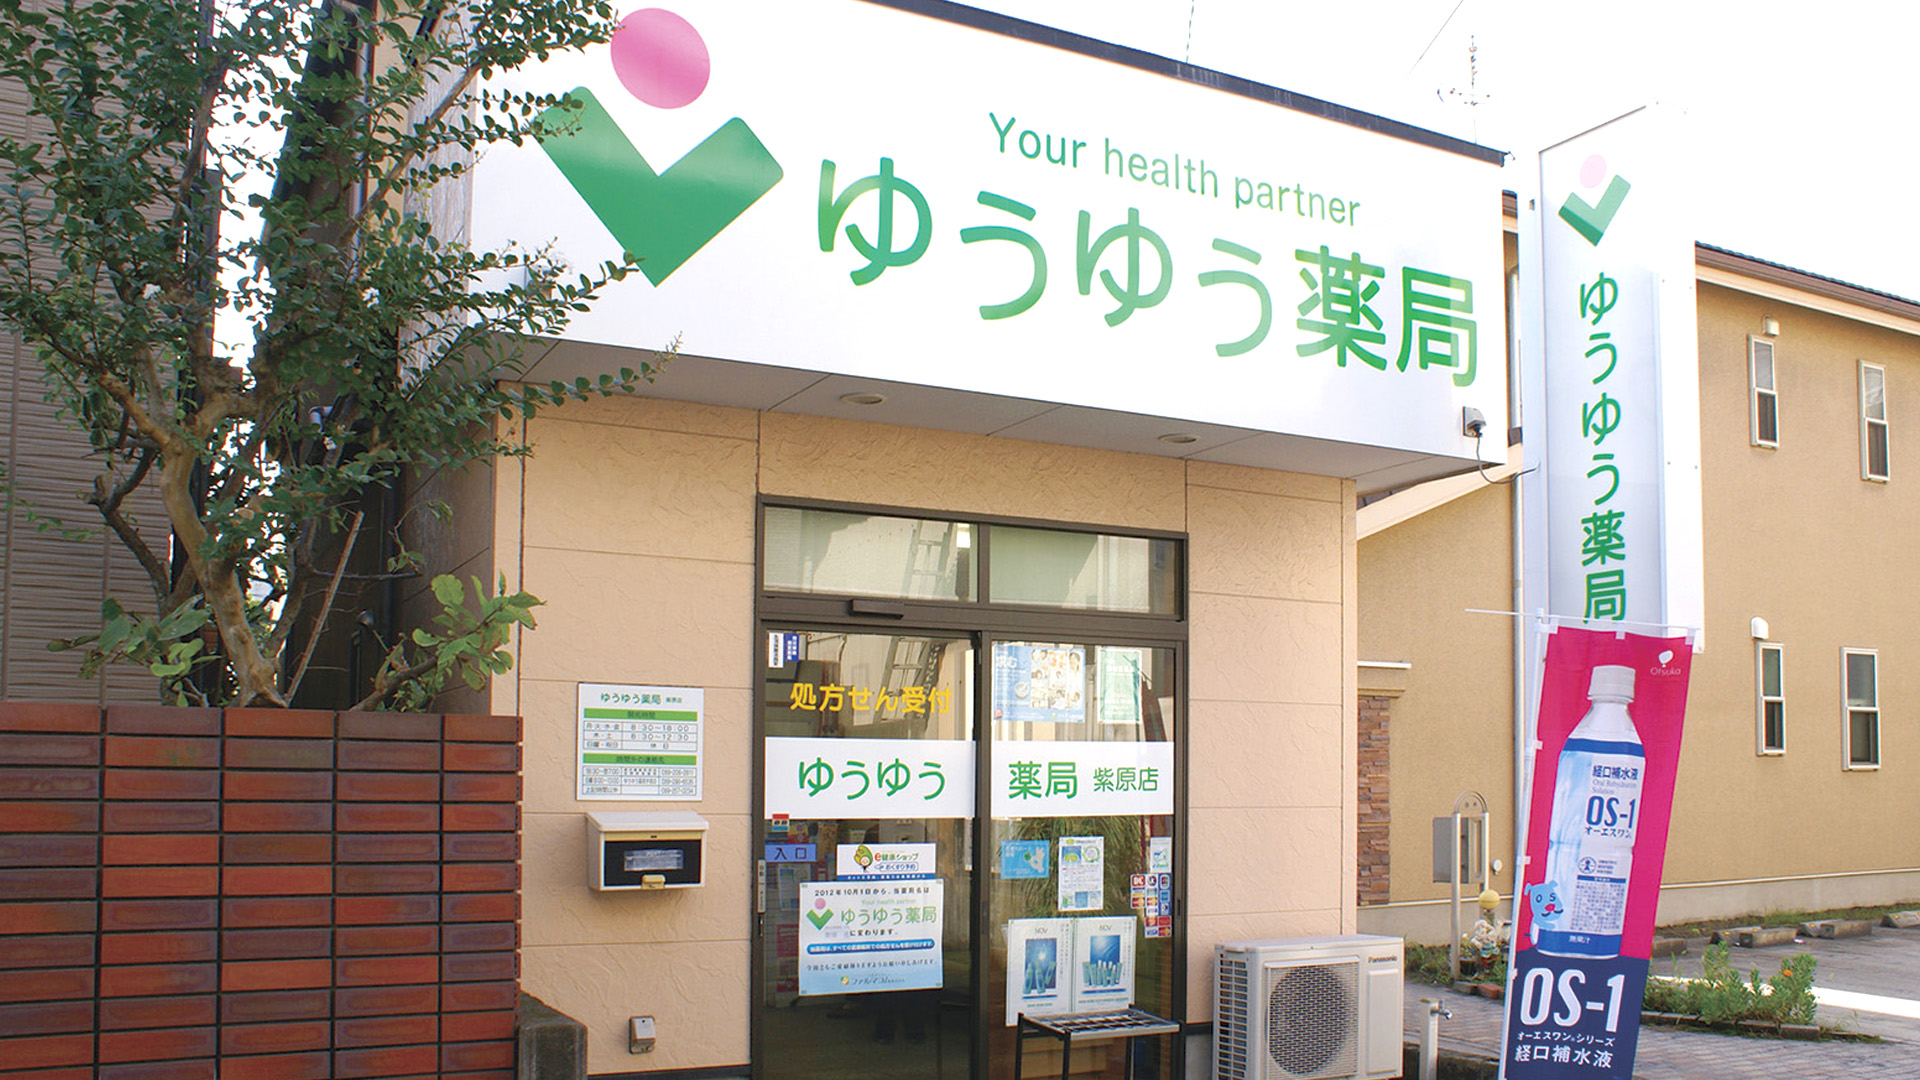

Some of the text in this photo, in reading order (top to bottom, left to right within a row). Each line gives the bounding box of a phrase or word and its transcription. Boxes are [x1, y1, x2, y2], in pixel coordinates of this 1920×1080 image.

[989, 111, 1361, 226] Your health partner
[818, 157, 1477, 387] ゆうゆう薬局
[1579, 271, 1627, 624] ゆうゆう薬局
[1650, 667, 1681, 676] Otsuka
[600, 692, 662, 705] ゆうゆう薬局
[789, 683, 953, 714] 処方せん受付
[798, 757, 1159, 801] ゆうゆう 薬局 紫原店
[1592, 765, 1639, 780] 経口補水液
[1586, 795, 1637, 829] OS-1
[1585, 826, 1631, 839] オーエスワン
[774, 846, 808, 861] 入口
[874, 852, 919, 862] e健康ショップ
[841, 906, 937, 926] ゆうゆう薬局
[1367, 955, 1398, 964] Panasonic
[1521, 967, 1625, 1033] OS-1
[1514, 1044, 1614, 1069] 経口補水液
